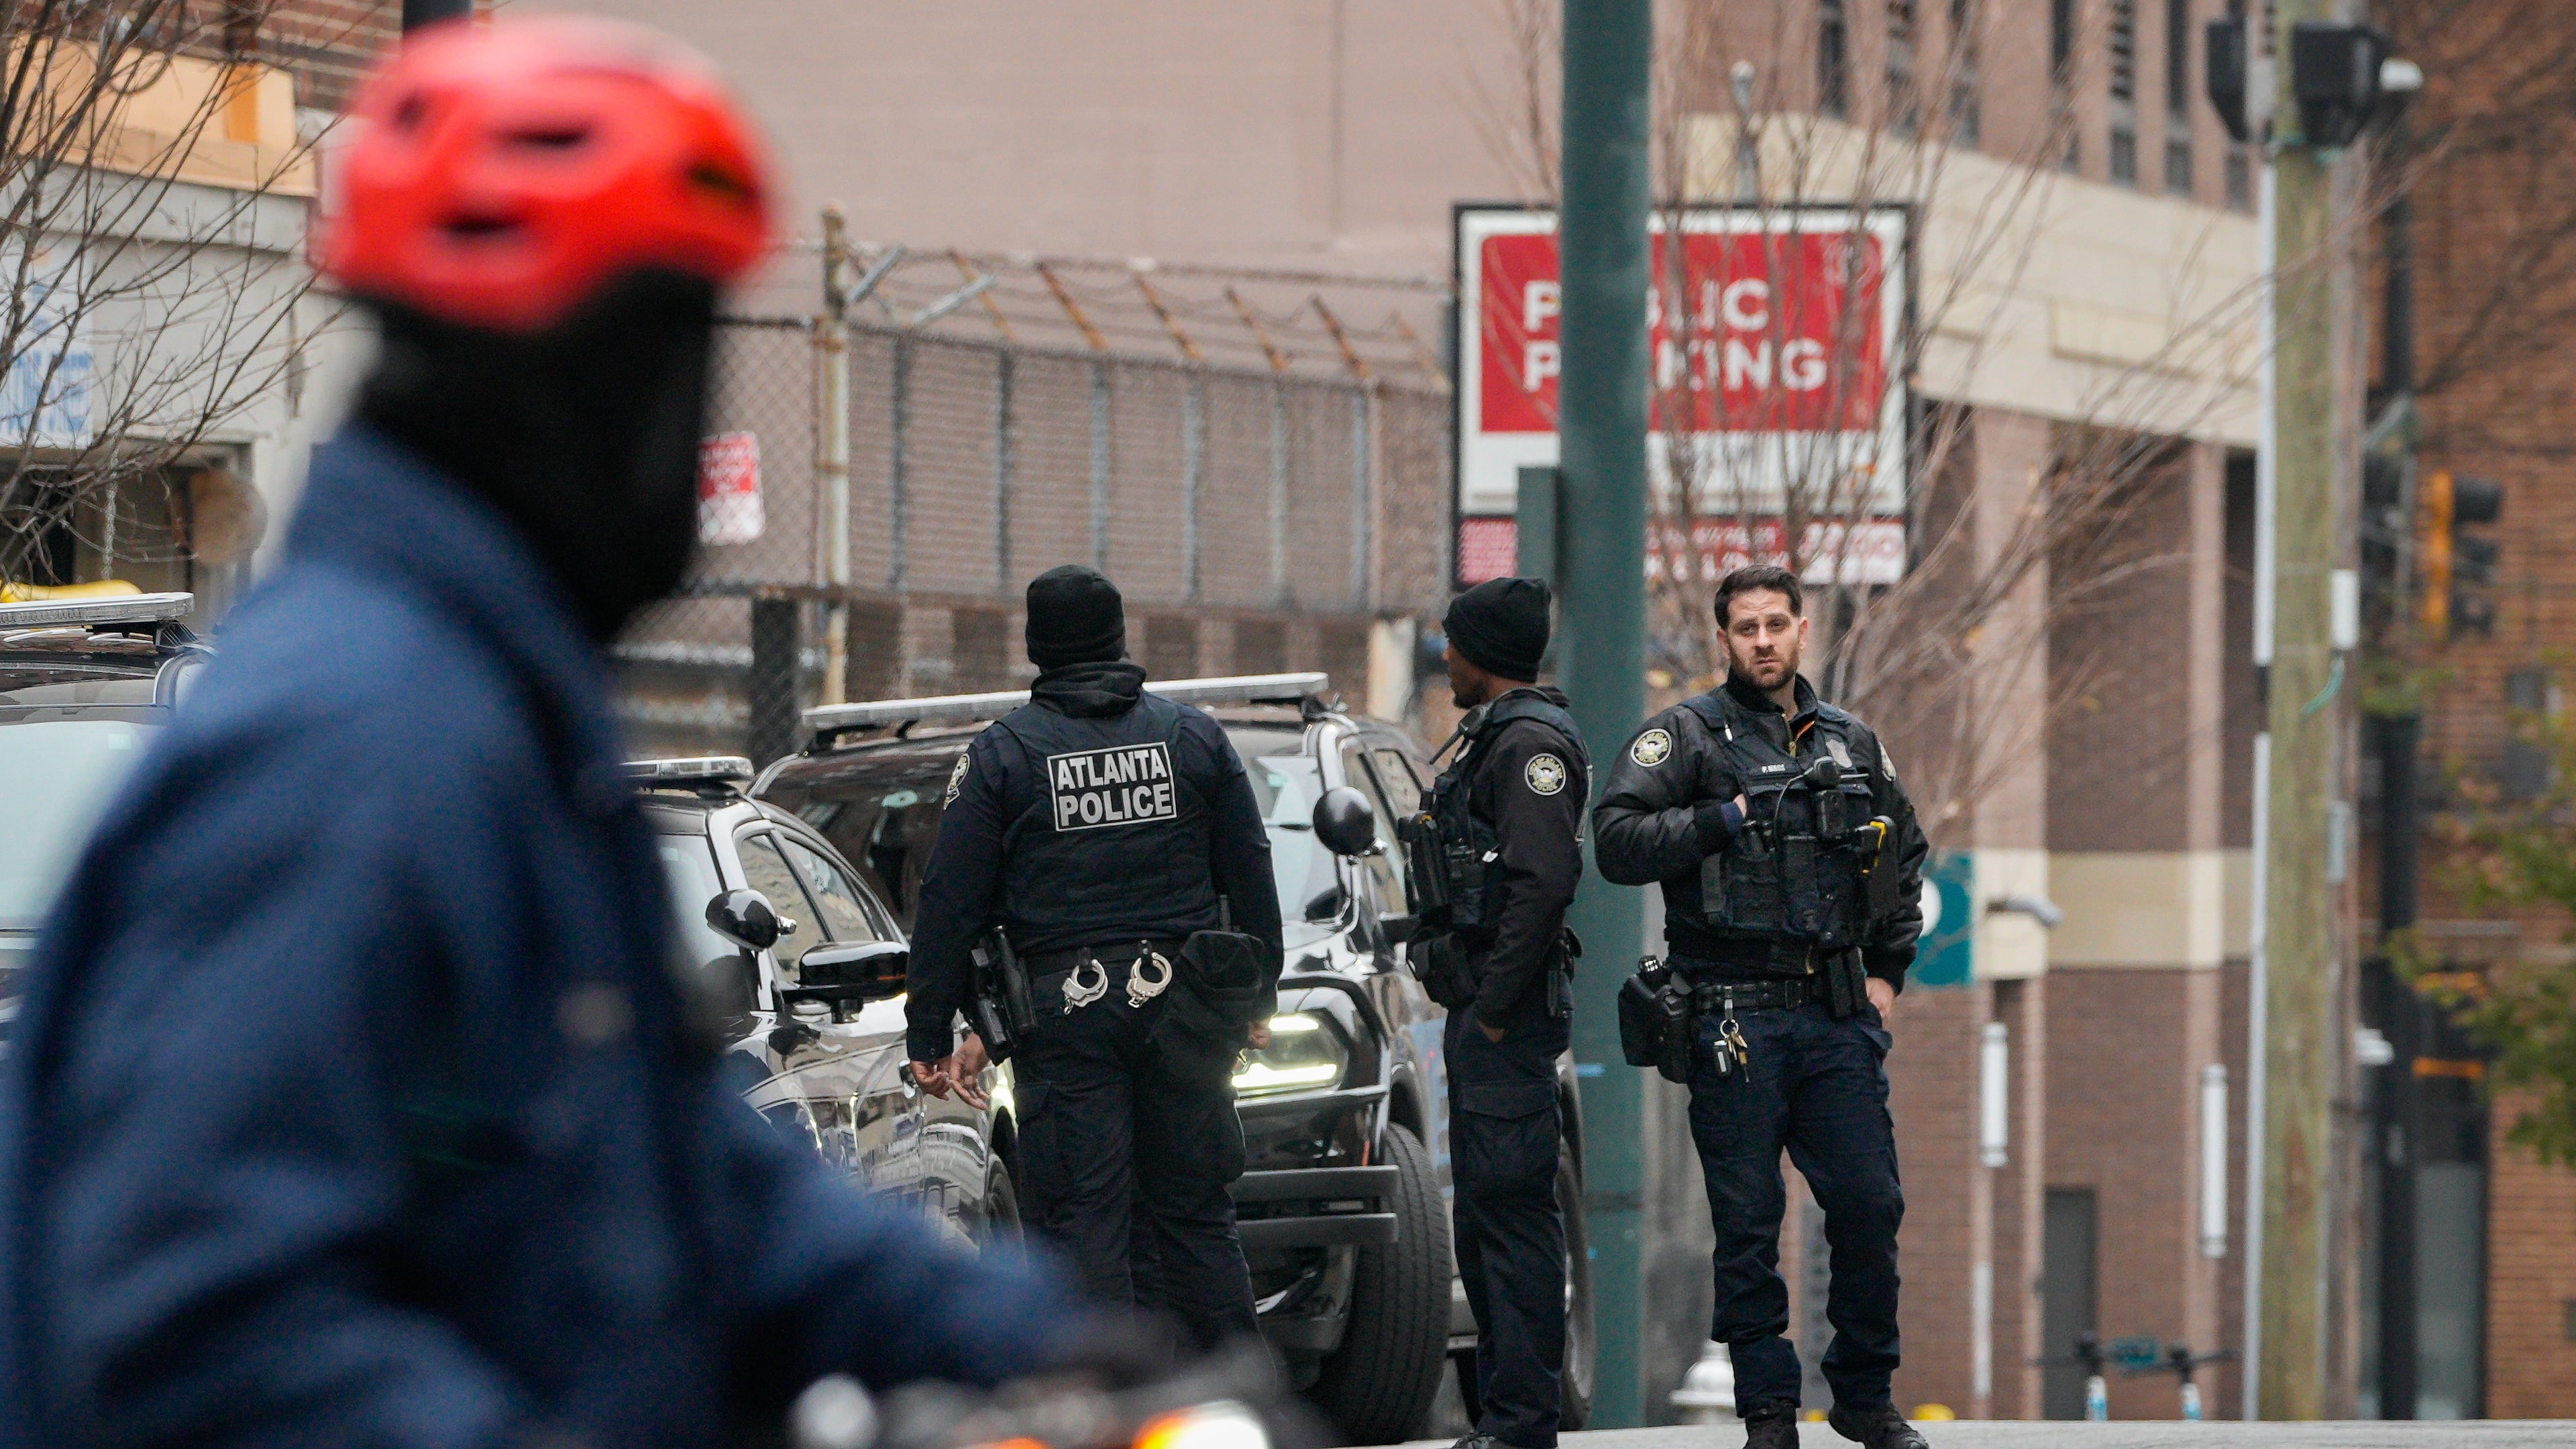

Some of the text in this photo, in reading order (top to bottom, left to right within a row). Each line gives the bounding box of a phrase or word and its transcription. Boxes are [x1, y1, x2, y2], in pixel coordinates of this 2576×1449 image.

[1523, 337, 1827, 392] PKING
[1057, 749, 1167, 791] ATLANTA
[1058, 783, 1173, 826] POLICE
